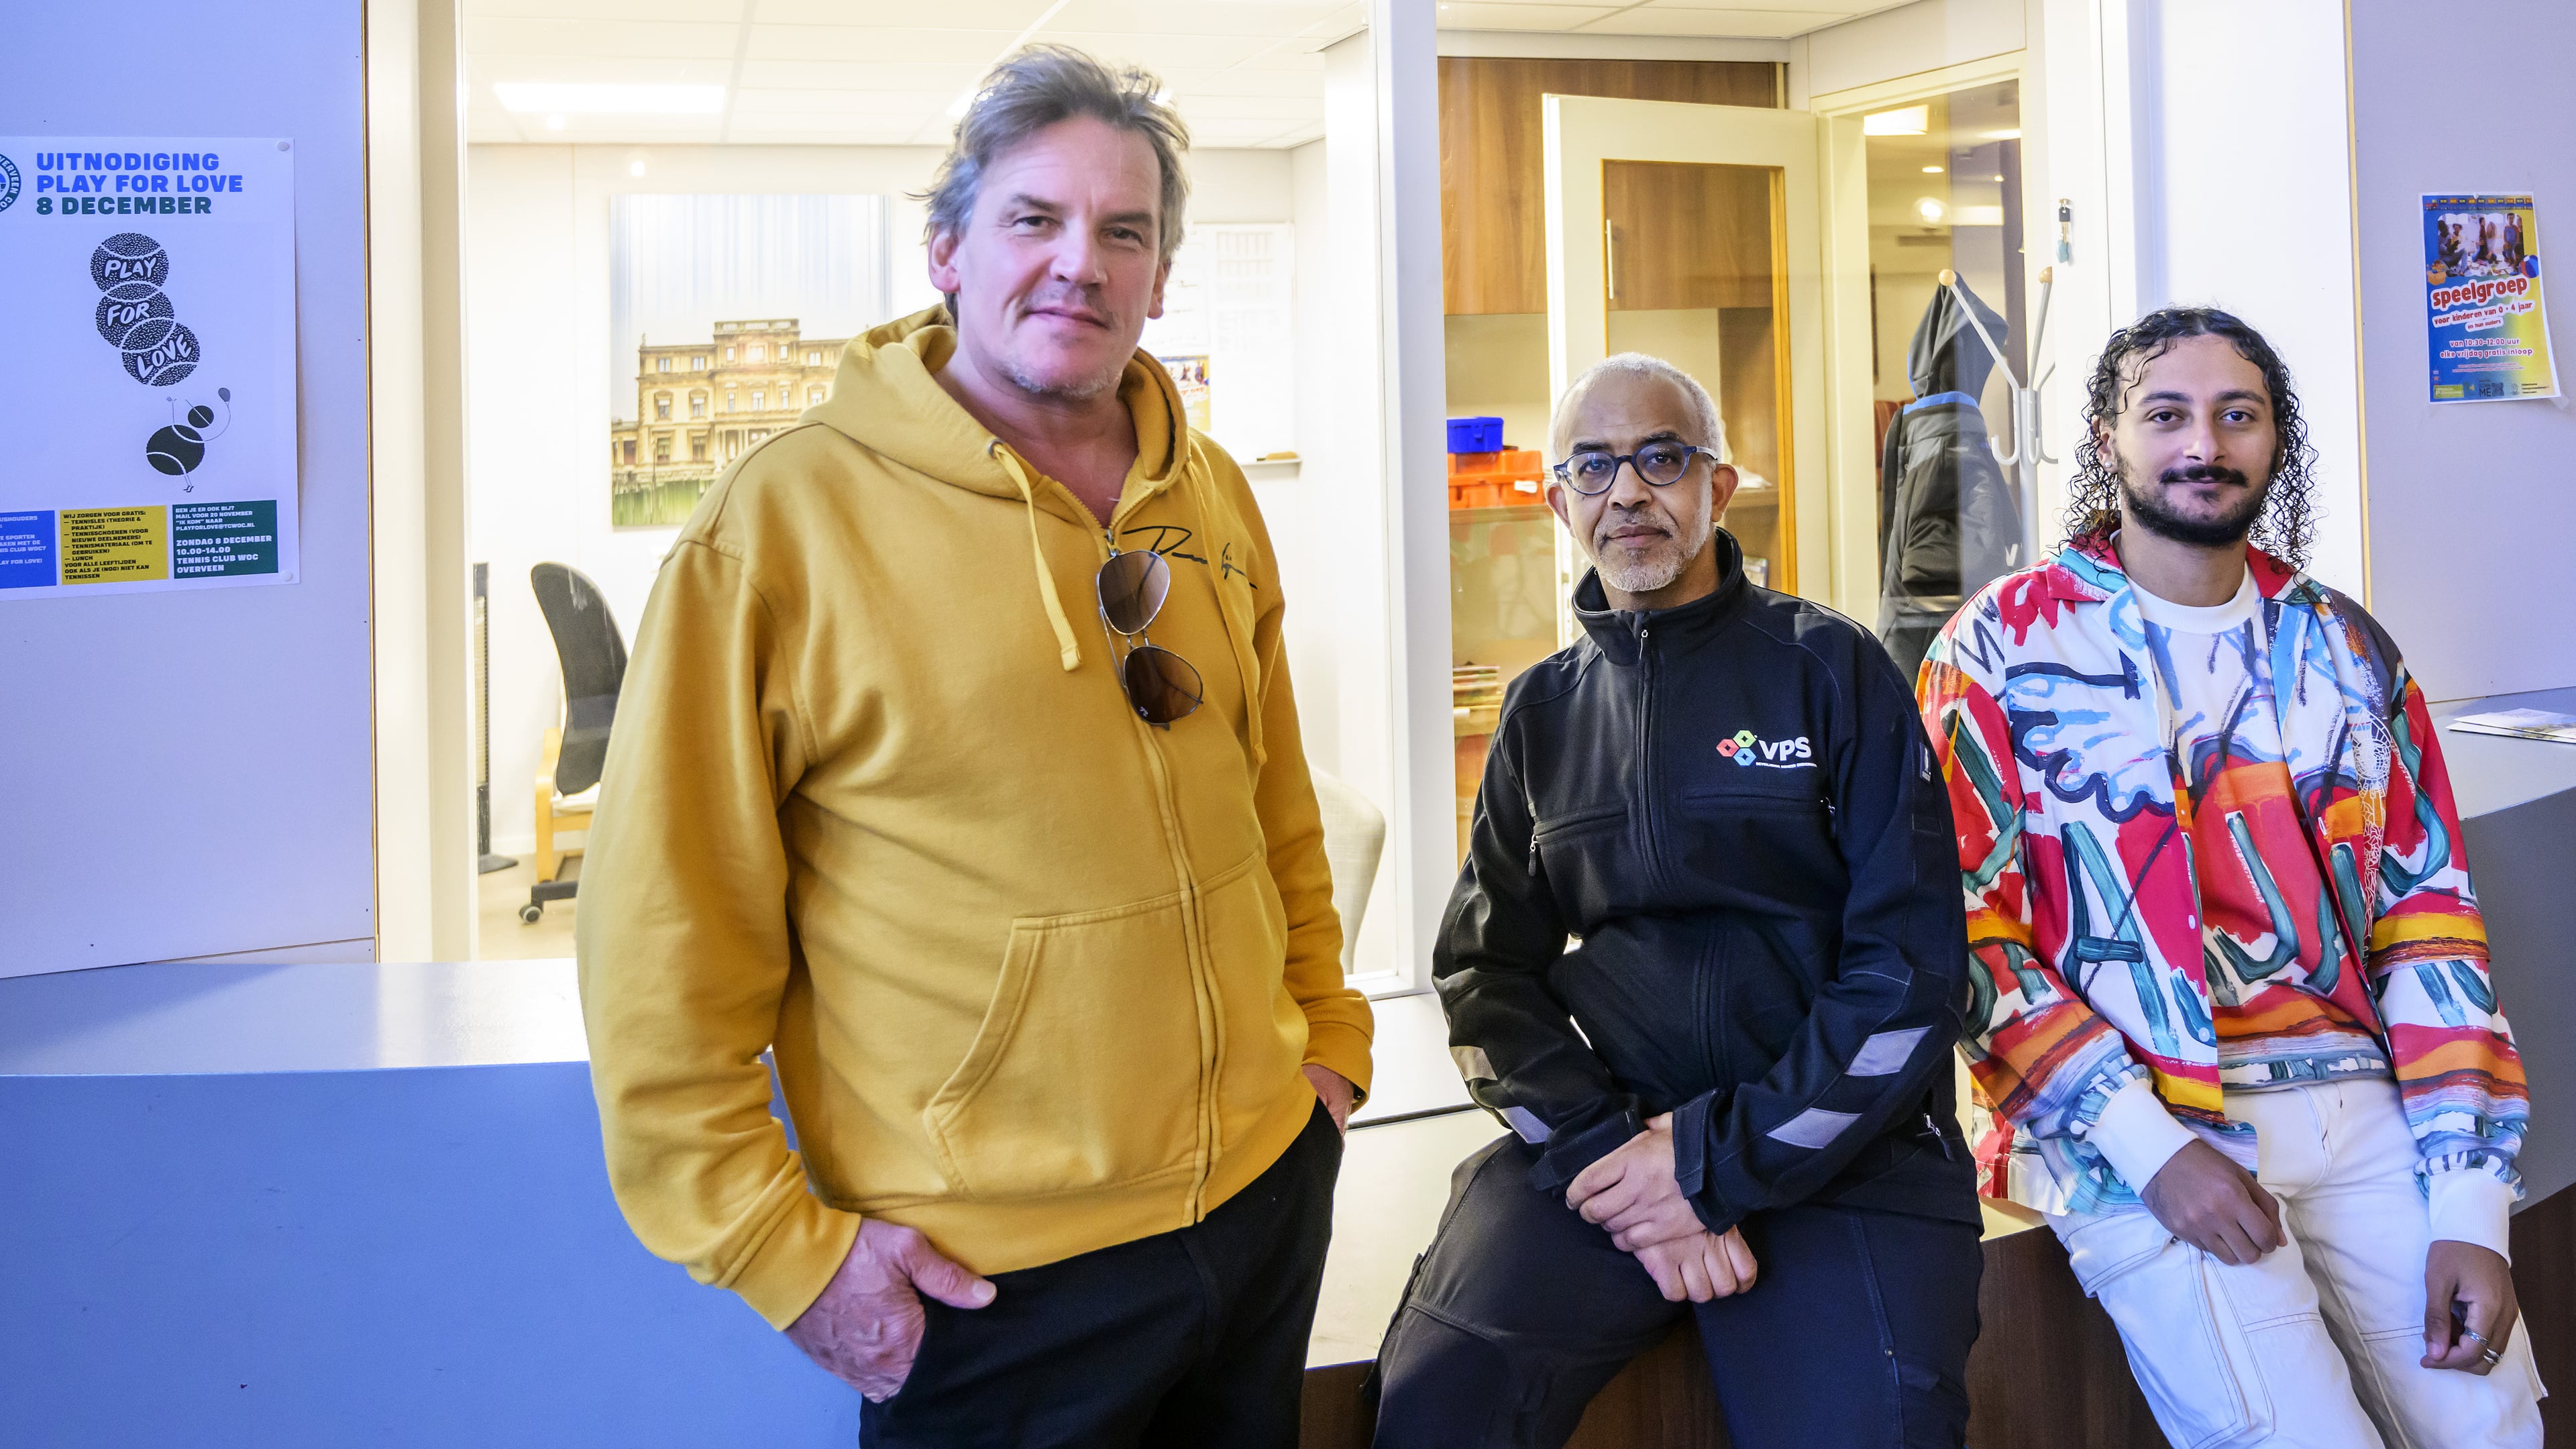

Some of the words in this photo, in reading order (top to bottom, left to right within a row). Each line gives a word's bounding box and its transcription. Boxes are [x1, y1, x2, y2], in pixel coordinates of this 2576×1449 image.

[36, 152, 219, 170] UITNODIGING
[0, 156, 19, 194] VERVEEN
[37, 175, 107, 193] PLAY
[116, 175, 168, 193] FOR
[177, 175, 243, 192] LOVE
[36, 197, 53, 215] 8
[62, 197, 211, 215] DECEMBER
[105, 258, 156, 279] PLAY
[2432, 278, 2527, 308] speelgroep
[107, 302, 150, 327] FOR
[2518, 303, 2532, 312] jaar
[137, 334, 192, 379] LOVE
[2457, 350, 2482, 358] vrijdag
[2484, 349, 2506, 358] gratis
[2479, 388, 2491, 397] ME
[223, 535, 272, 544] DECEMBER
[176, 547, 230, 555] 10.00-14.00
[177, 565, 224, 573] OVERVEEN
[1758, 737, 1811, 761] VPS
